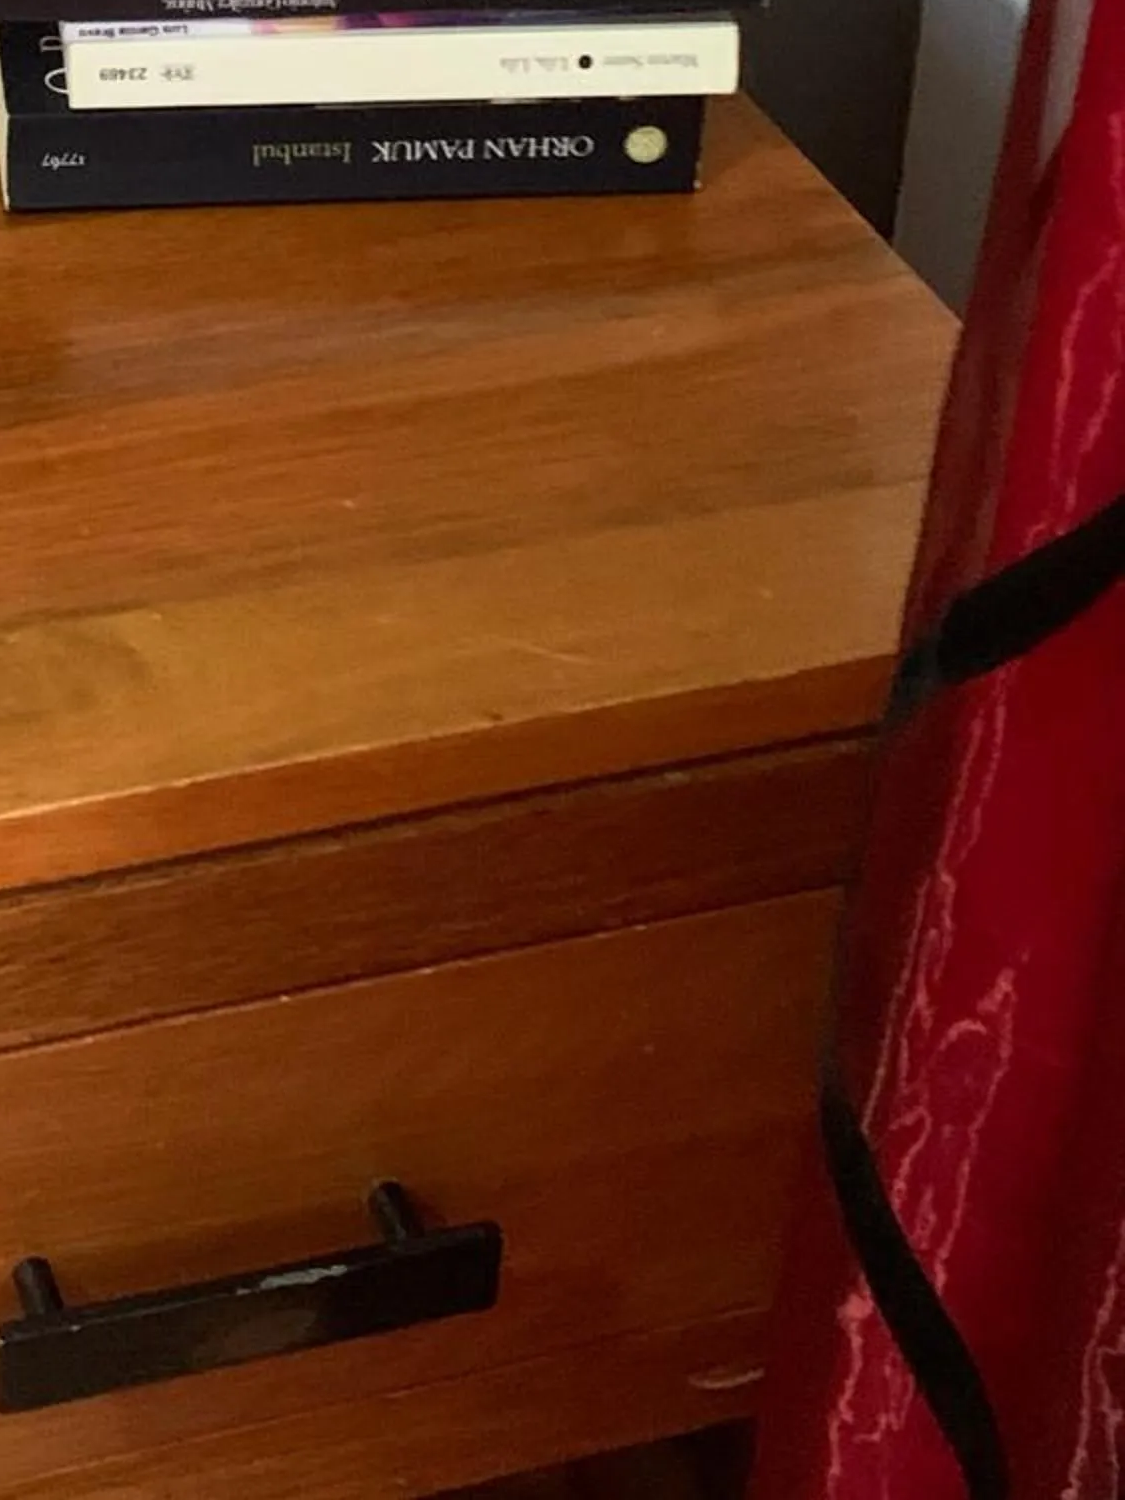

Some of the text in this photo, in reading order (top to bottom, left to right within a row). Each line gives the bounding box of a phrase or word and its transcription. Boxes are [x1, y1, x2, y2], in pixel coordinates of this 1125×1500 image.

[39, 150, 86, 170] 17767
[251, 140, 353, 167] Istanbul
[369, 133, 595, 163] ORHAN PAMUK
